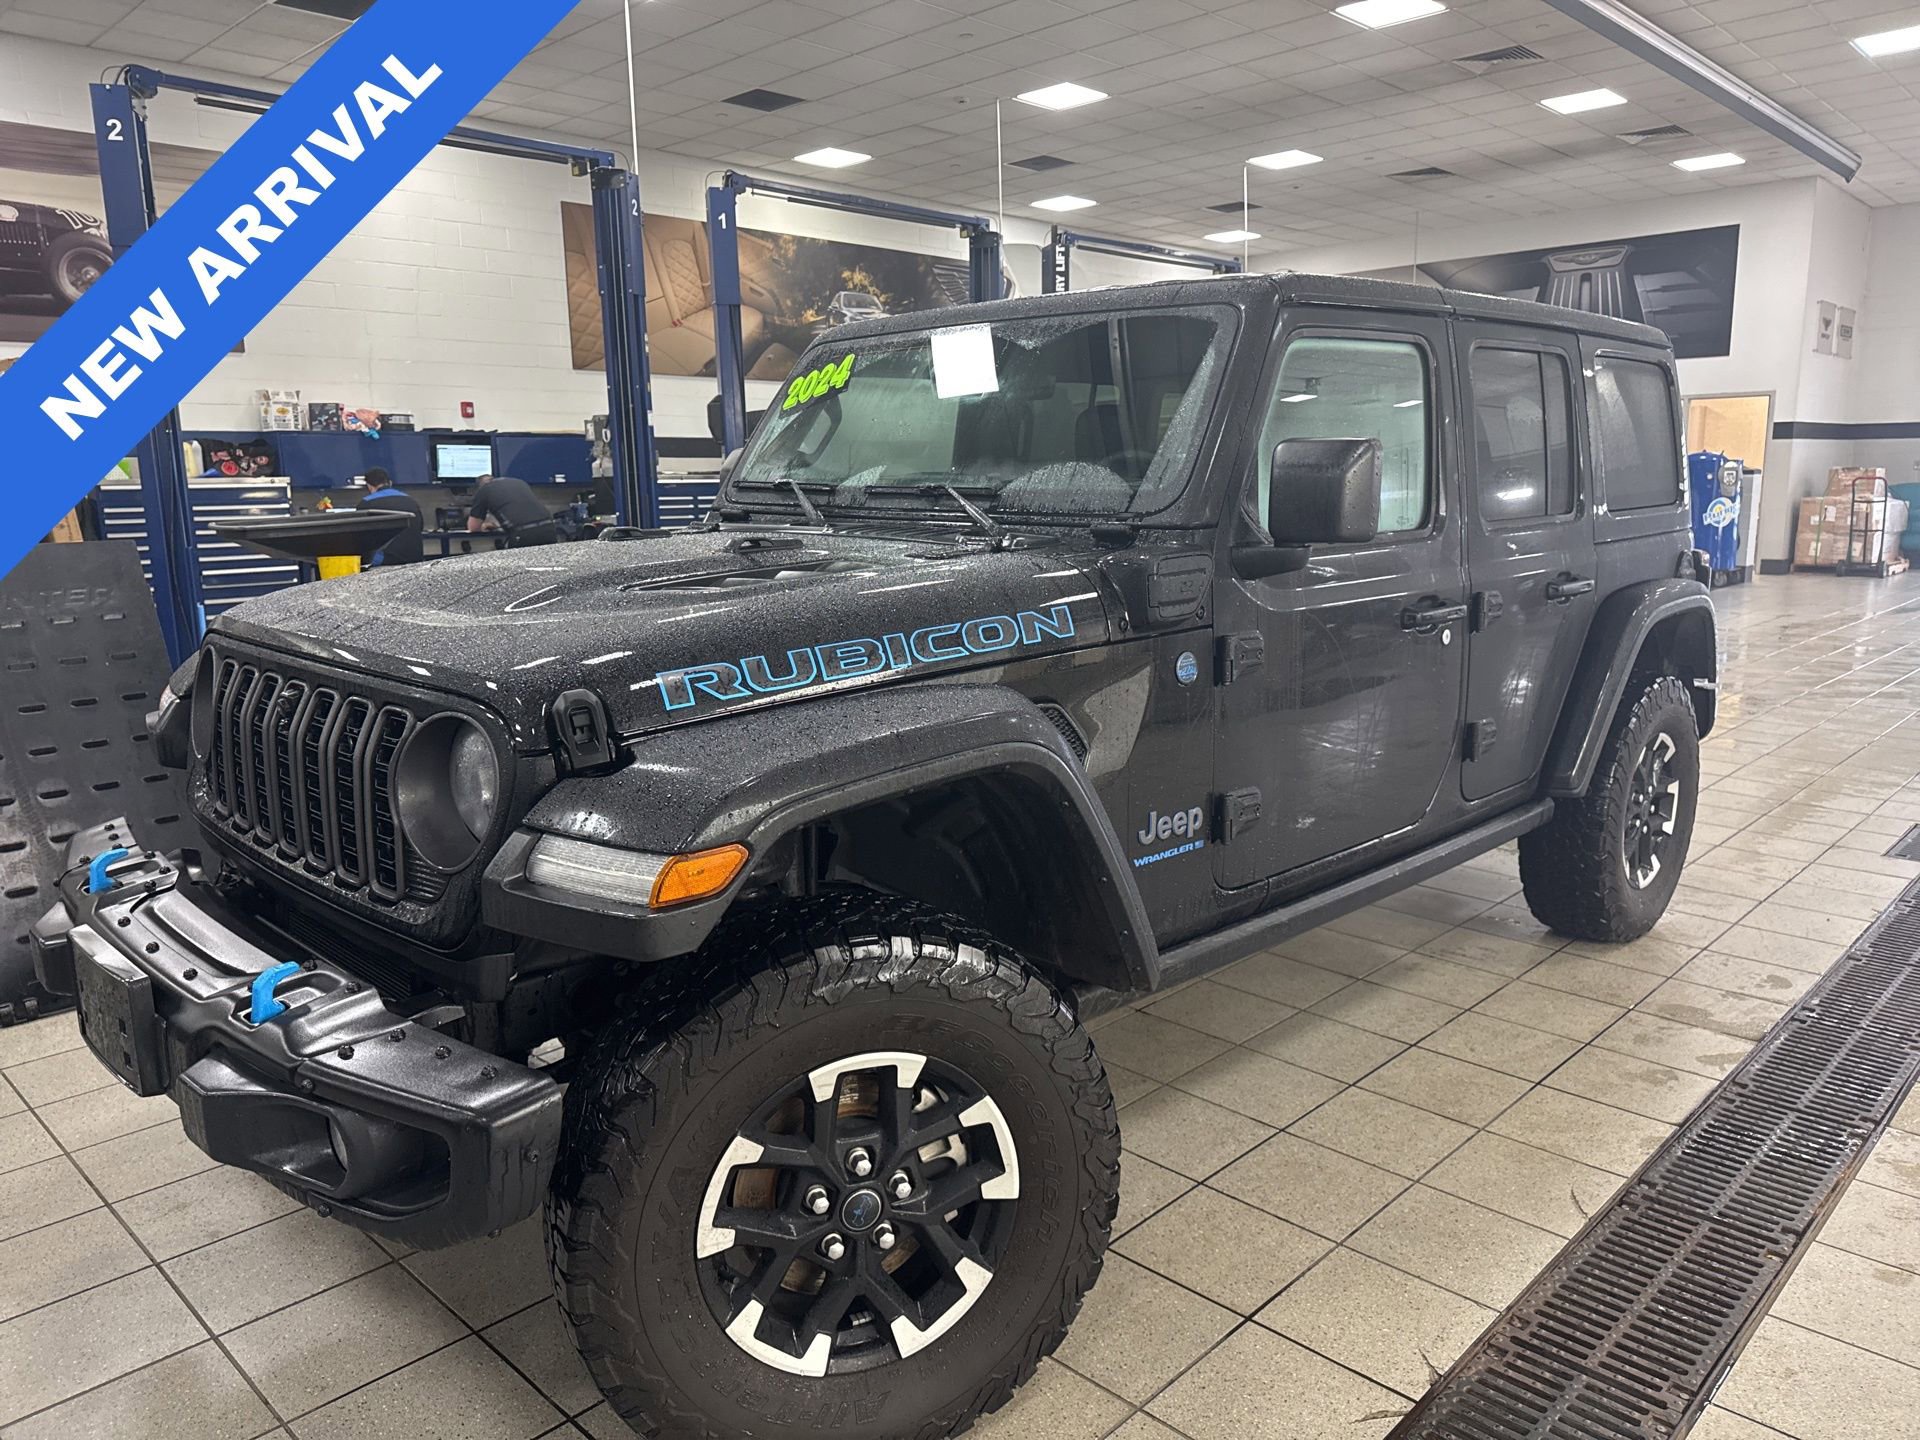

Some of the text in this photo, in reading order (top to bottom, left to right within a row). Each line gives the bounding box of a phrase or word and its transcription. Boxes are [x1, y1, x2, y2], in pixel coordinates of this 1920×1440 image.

[106, 118, 124, 141] 2
[631, 198, 639, 216] 2
[718, 212, 727, 230] 1
[1055, 243, 1066, 272] LIFT
[782, 353, 856, 411] 2024
[656, 604, 1076, 712] RUBICON
[1137, 806, 1204, 846] Jeep
[1133, 842, 1195, 868] WRANGLER
